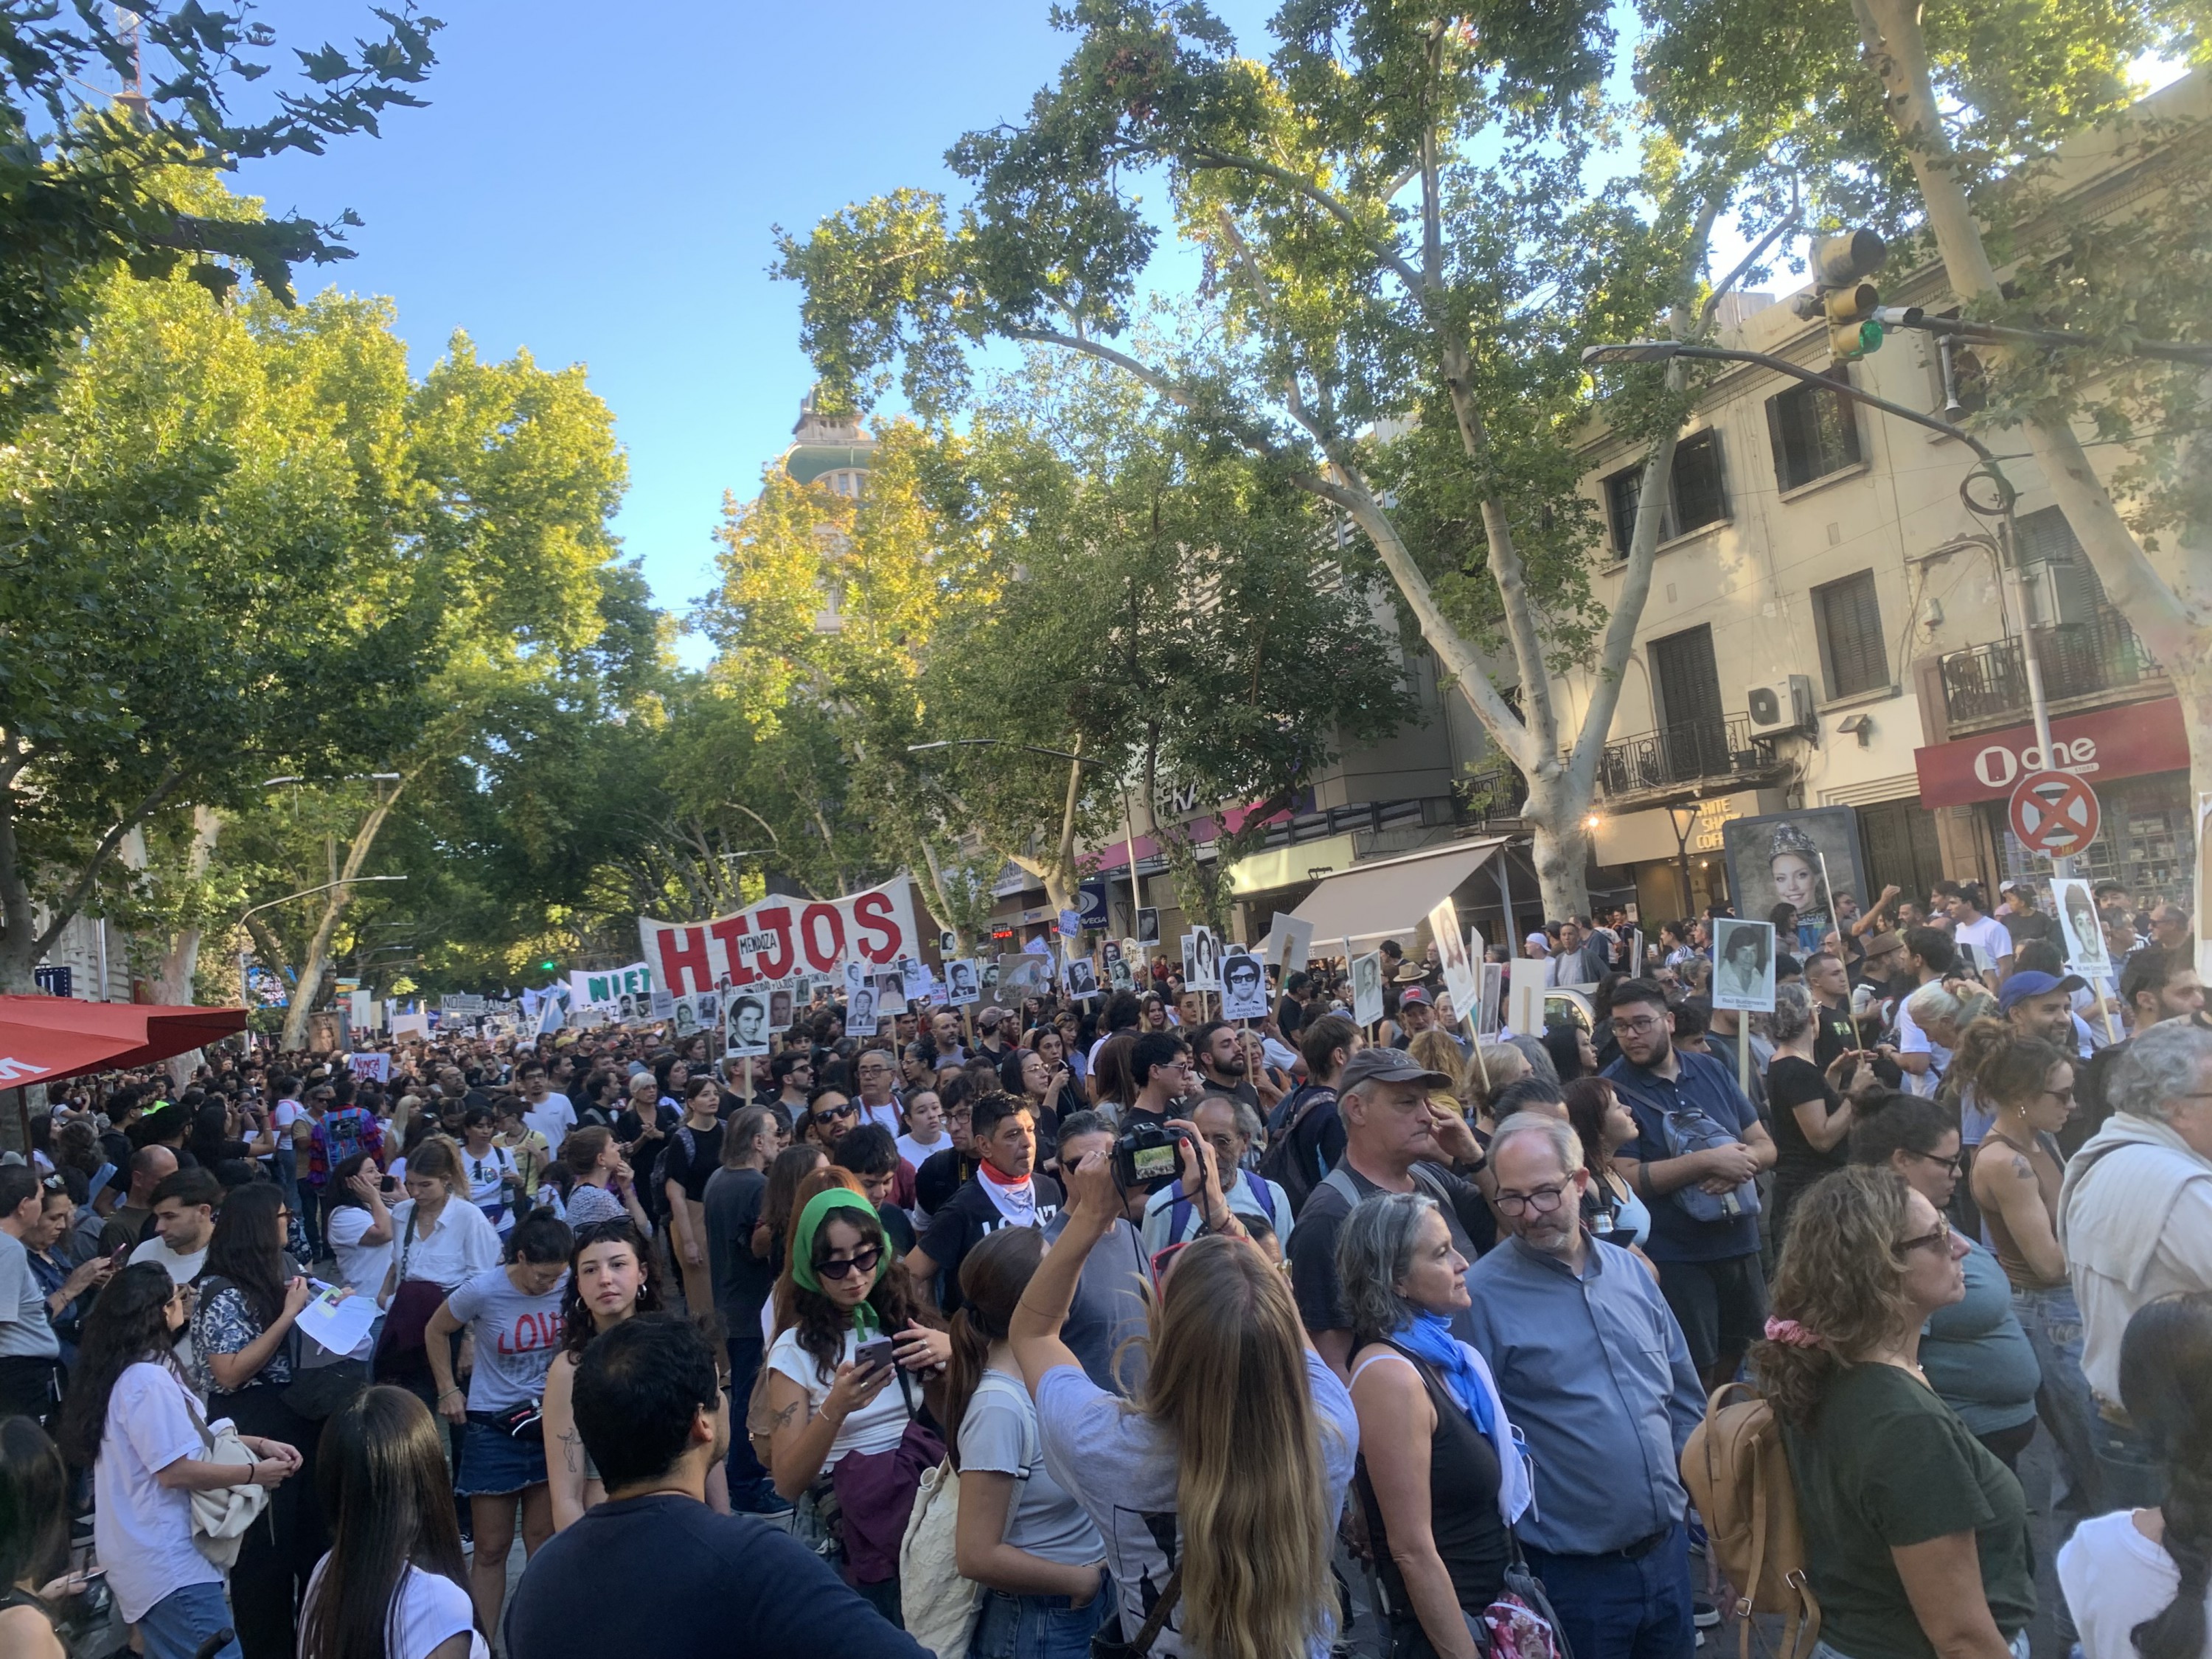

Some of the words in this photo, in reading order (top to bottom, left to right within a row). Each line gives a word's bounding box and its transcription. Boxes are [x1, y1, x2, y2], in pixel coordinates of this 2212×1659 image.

[2021, 738, 2096, 770] one
[740, 932, 778, 955] MENDOZA
[444, 996, 458, 1008] NO
[354, 1057, 380, 1069] NUNCA
